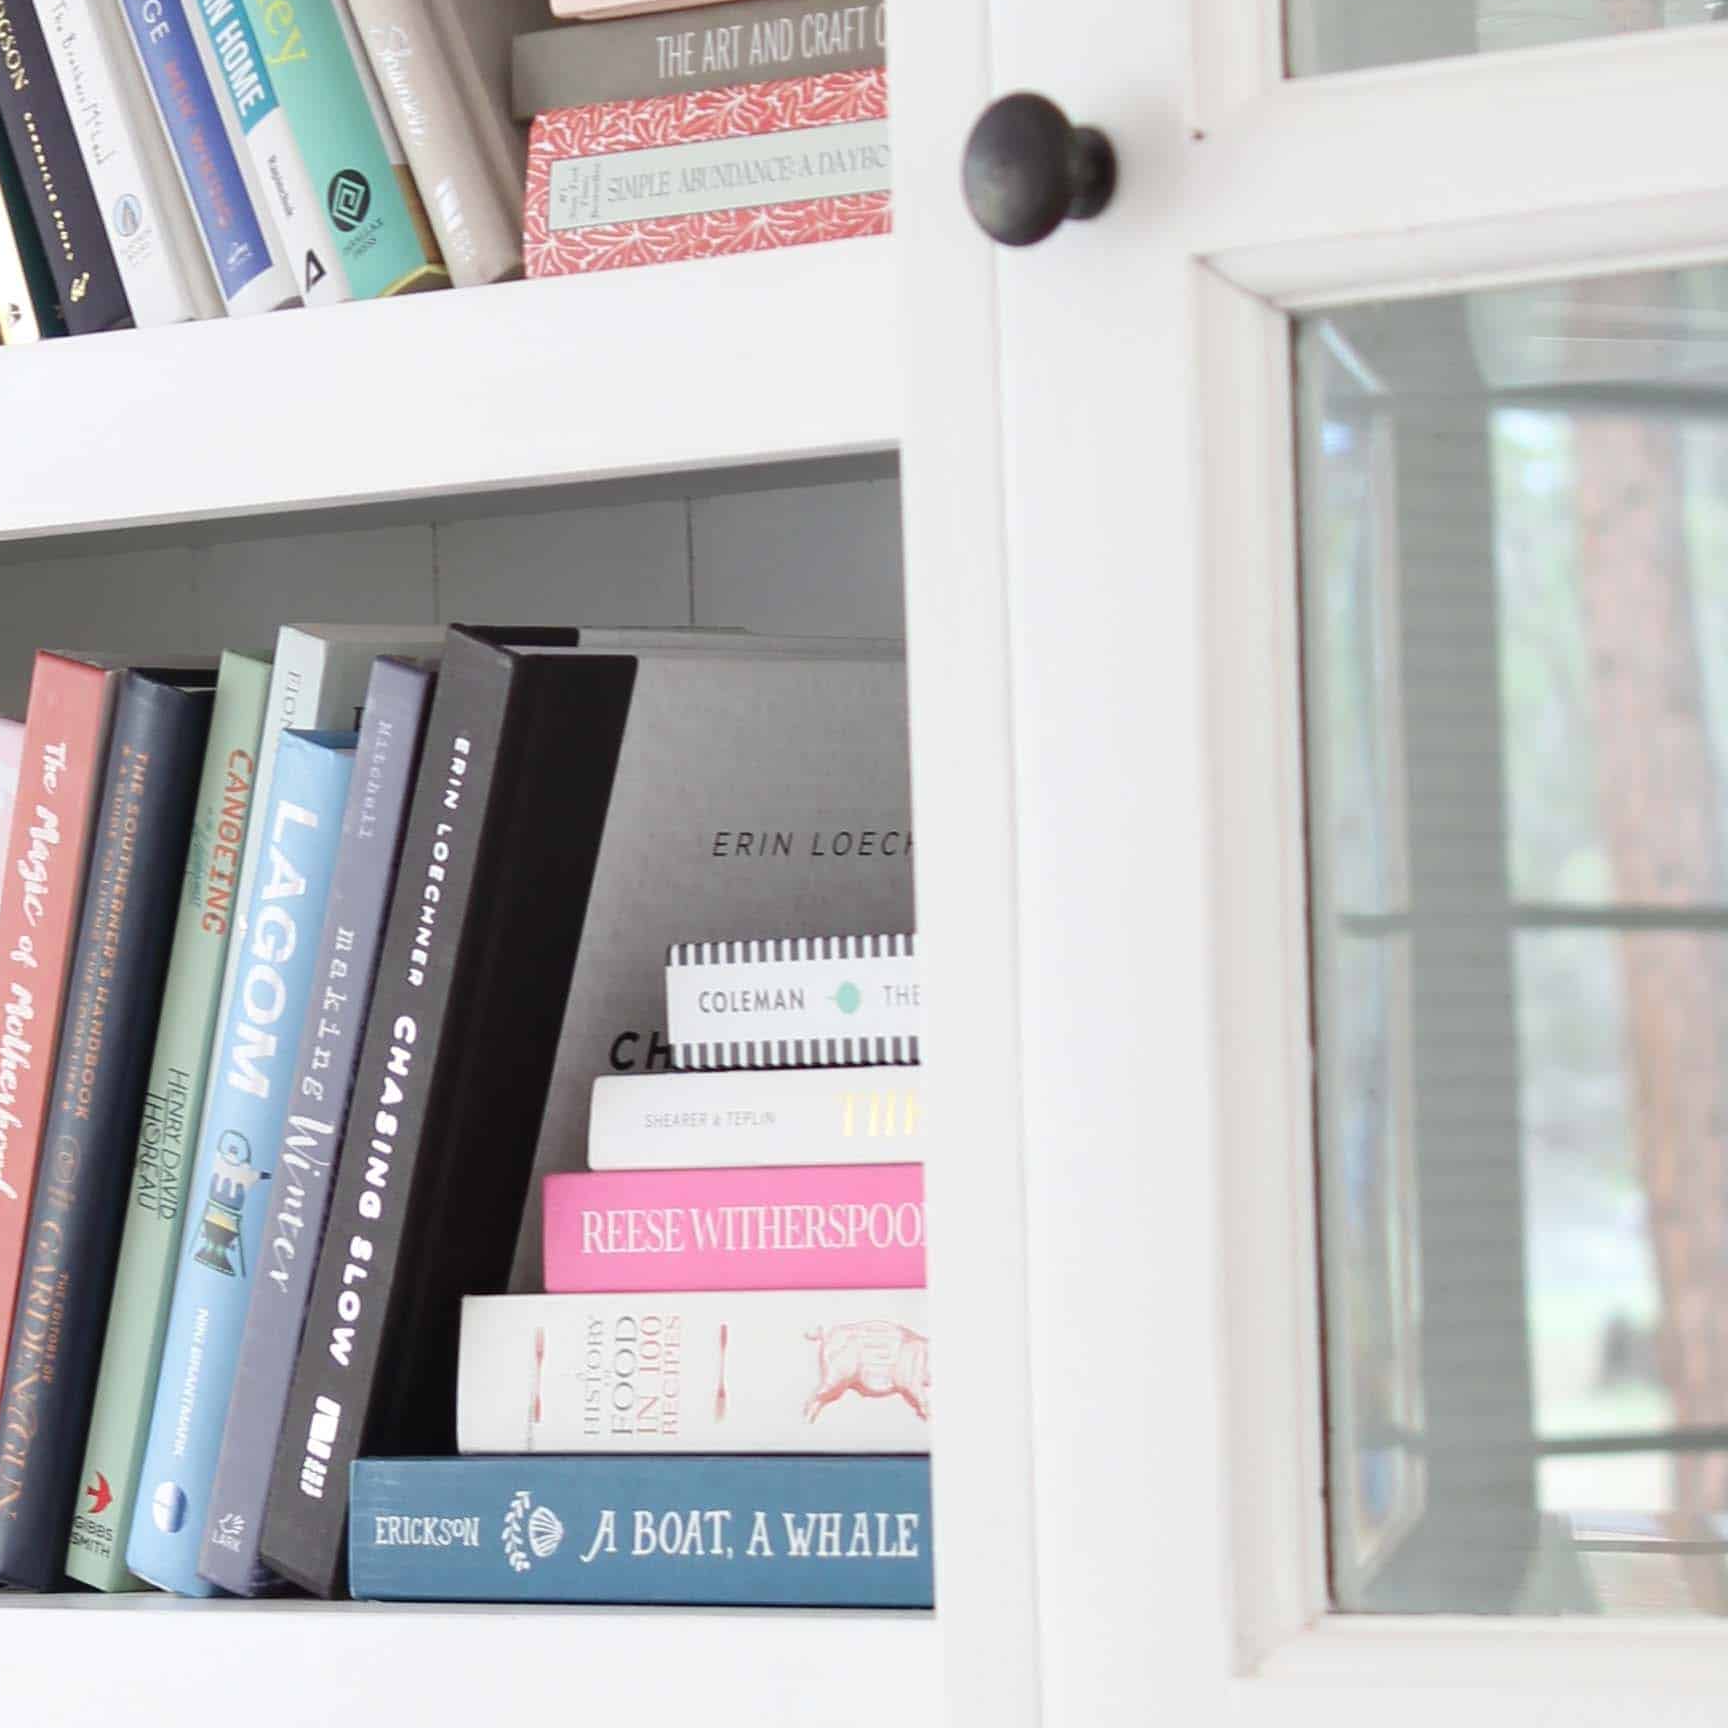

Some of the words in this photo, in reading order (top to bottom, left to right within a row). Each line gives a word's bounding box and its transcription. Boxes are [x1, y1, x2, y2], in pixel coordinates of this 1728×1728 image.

[219, 18, 267, 118] HOME
[655, 32, 696, 80] THE
[702, 25, 743, 62] ART
[749, 18, 794, 65] AND
[800, 7, 870, 60] CRAFT
[41, 741, 68, 803] The
[444, 734, 472, 809] ERIN
[17, 804, 63, 925] Magic
[201, 748, 254, 936] CANOEING
[712, 831, 794, 857] ERIN
[407, 823, 449, 987] LOECHNER
[11, 927, 39, 969] of
[227, 799, 320, 1101] LAGOM
[301, 925, 357, 1103] making
[698, 988, 806, 1014] COLEMAN
[164, 1068, 190, 1144] HENRY
[359, 1014, 418, 1223] CHASING
[138, 1091, 167, 1211] THOREAU
[161, 1148, 181, 1219] DAVID
[581, 1208, 685, 1254] REESE
[328, 1234, 373, 1367] SLOW
[610, 1314, 638, 1436] FOOD
[71, 1531, 111, 1558] SMITH
[72, 1514, 112, 1541] GIBBS
[375, 1516, 480, 1547] ERICKSON
[632, 1510, 734, 1559] BOAT,
[746, 1512, 773, 1557] A
[782, 1512, 919, 1558] WHALE
